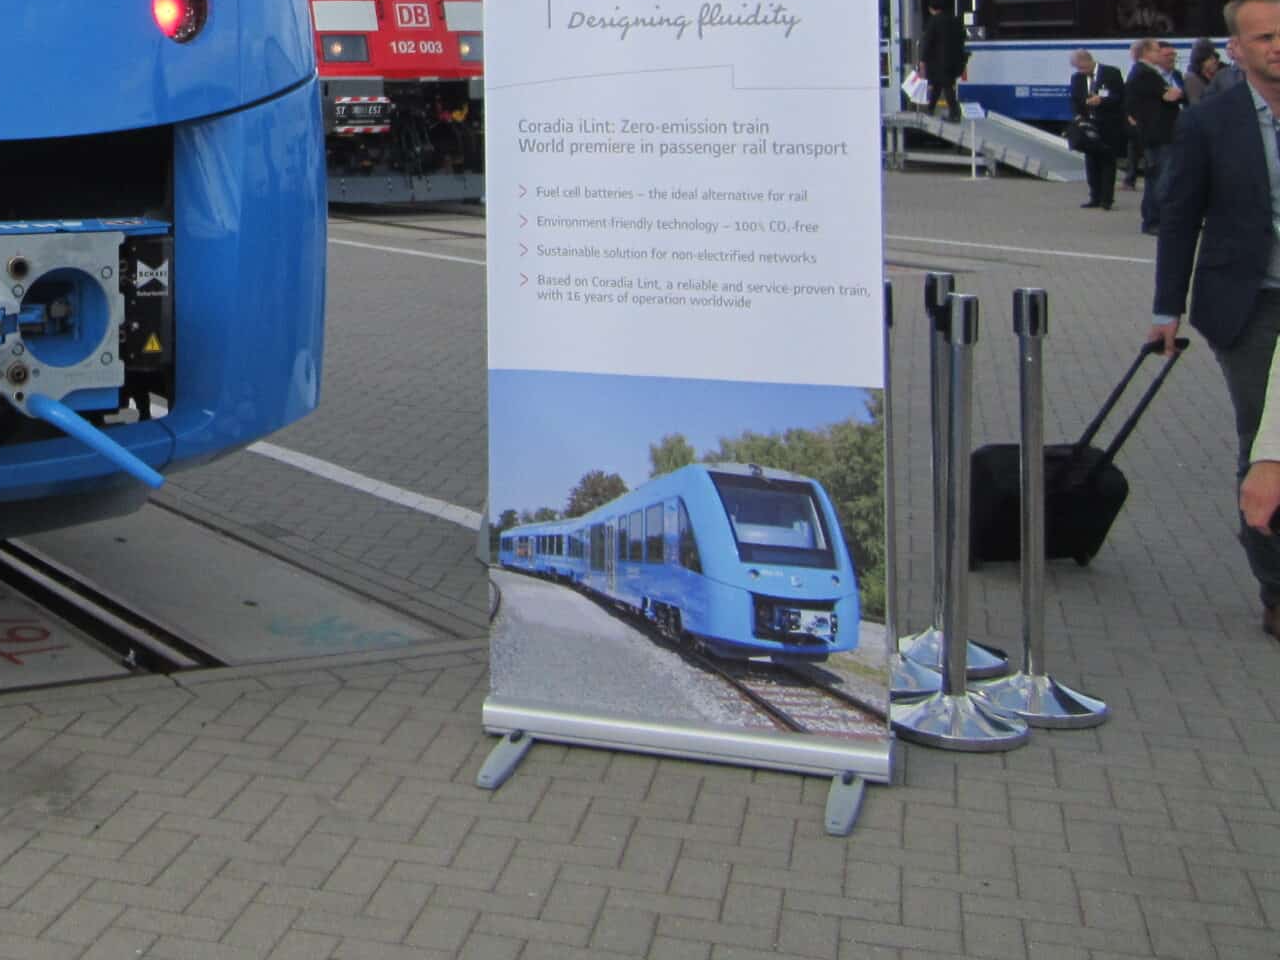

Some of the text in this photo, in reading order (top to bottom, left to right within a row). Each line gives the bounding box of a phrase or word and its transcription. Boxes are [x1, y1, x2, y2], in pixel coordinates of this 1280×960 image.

[397, 5, 429, 26] DB
[568, 2, 803, 41] Designing fluidity
[390, 40, 443, 54] 102 003
[518, 118, 770, 135] Coradia iLint: Zero-emission train
[518, 138, 849, 158] World premiere in passenger rail transport
[536, 186, 560, 198] Fuel
[563, 187, 581, 199] cell
[584, 187, 634, 200] batteries
[648, 188, 668, 200] the
[671, 188, 698, 201] ideal
[702, 189, 764, 202] alternative
[767, 189, 785, 202] for
[788, 190, 808, 202] rail
[536, 216, 654, 231] Environment-friendly
[656, 218, 719, 234] technology
[536, 244, 817, 264] Sustainable solution for non-electrified networks
[537, 274, 571, 287] Based
[574, 277, 589, 288] on
[591, 276, 633, 289] Coradia
[637, 278, 661, 291] Lint,
[677, 279, 718, 291] reliable
[722, 281, 744, 293] and
[747, 282, 836, 296] service-proven
[839, 284, 871, 298] train,
[537, 289, 752, 309] with 16 years of operation worldwide
